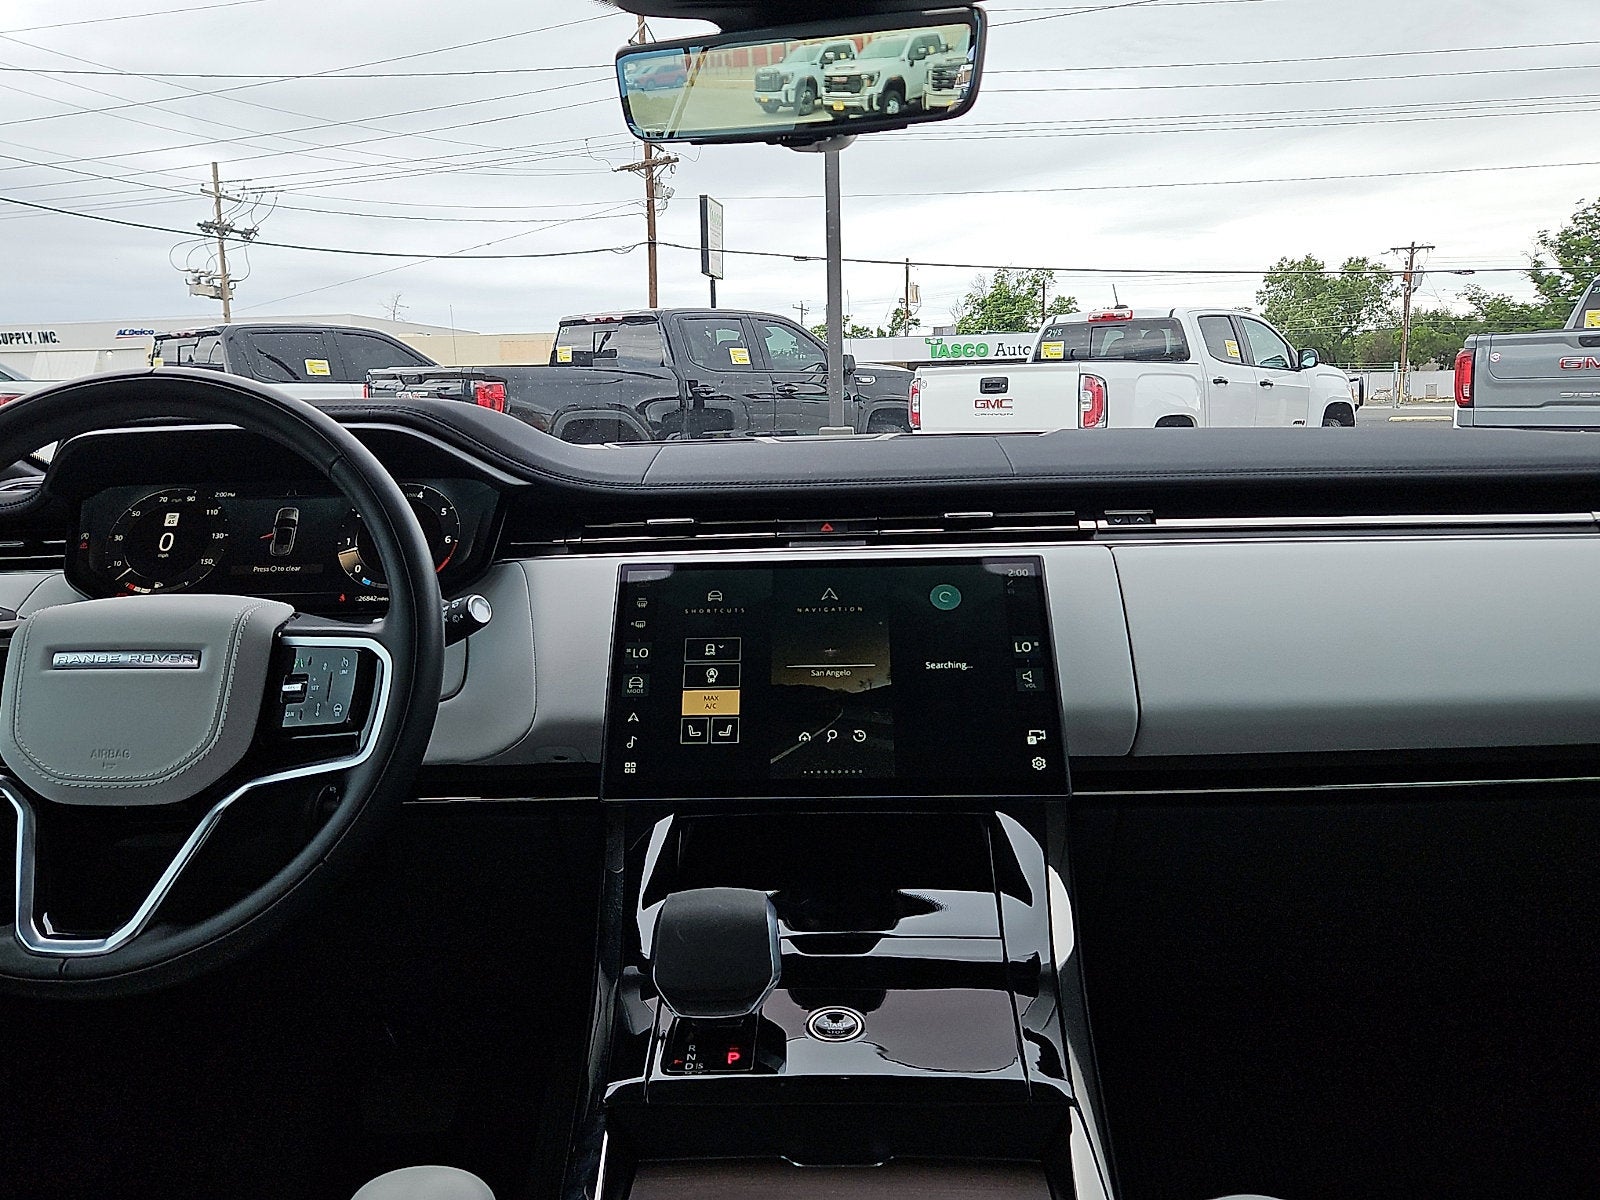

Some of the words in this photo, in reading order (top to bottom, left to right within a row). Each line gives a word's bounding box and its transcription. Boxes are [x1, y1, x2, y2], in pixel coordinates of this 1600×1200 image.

[116, 328, 154, 336] ACDelco
[0, 331, 37, 345] UPPLY,
[38, 331, 60, 344] INC.
[925, 338, 989, 358] TASCO
[994, 343, 1032, 357] Auto
[974, 399, 1013, 409] GMC
[417, 491, 424, 499] 4
[440, 507, 447, 516] 5
[114, 534, 124, 542] 30
[159, 532, 174, 551] 0
[444, 535, 452, 544] 6
[200, 558, 214, 566] 150
[354, 564, 361, 573] 0
[1007, 568, 1029, 577] 2:00
[1014, 642, 1032, 652] LO
[633, 648, 649, 658] LO
[57, 654, 122, 665] RANGE
[128, 653, 195, 664] ROVER
[811, 669, 827, 677] San
[828, 669, 851, 678] Angelo
[90, 749, 131, 760] AIRBAG
[688, 1044, 696, 1052] R
[686, 1053, 697, 1061] N
[727, 1051, 740, 1065] P
